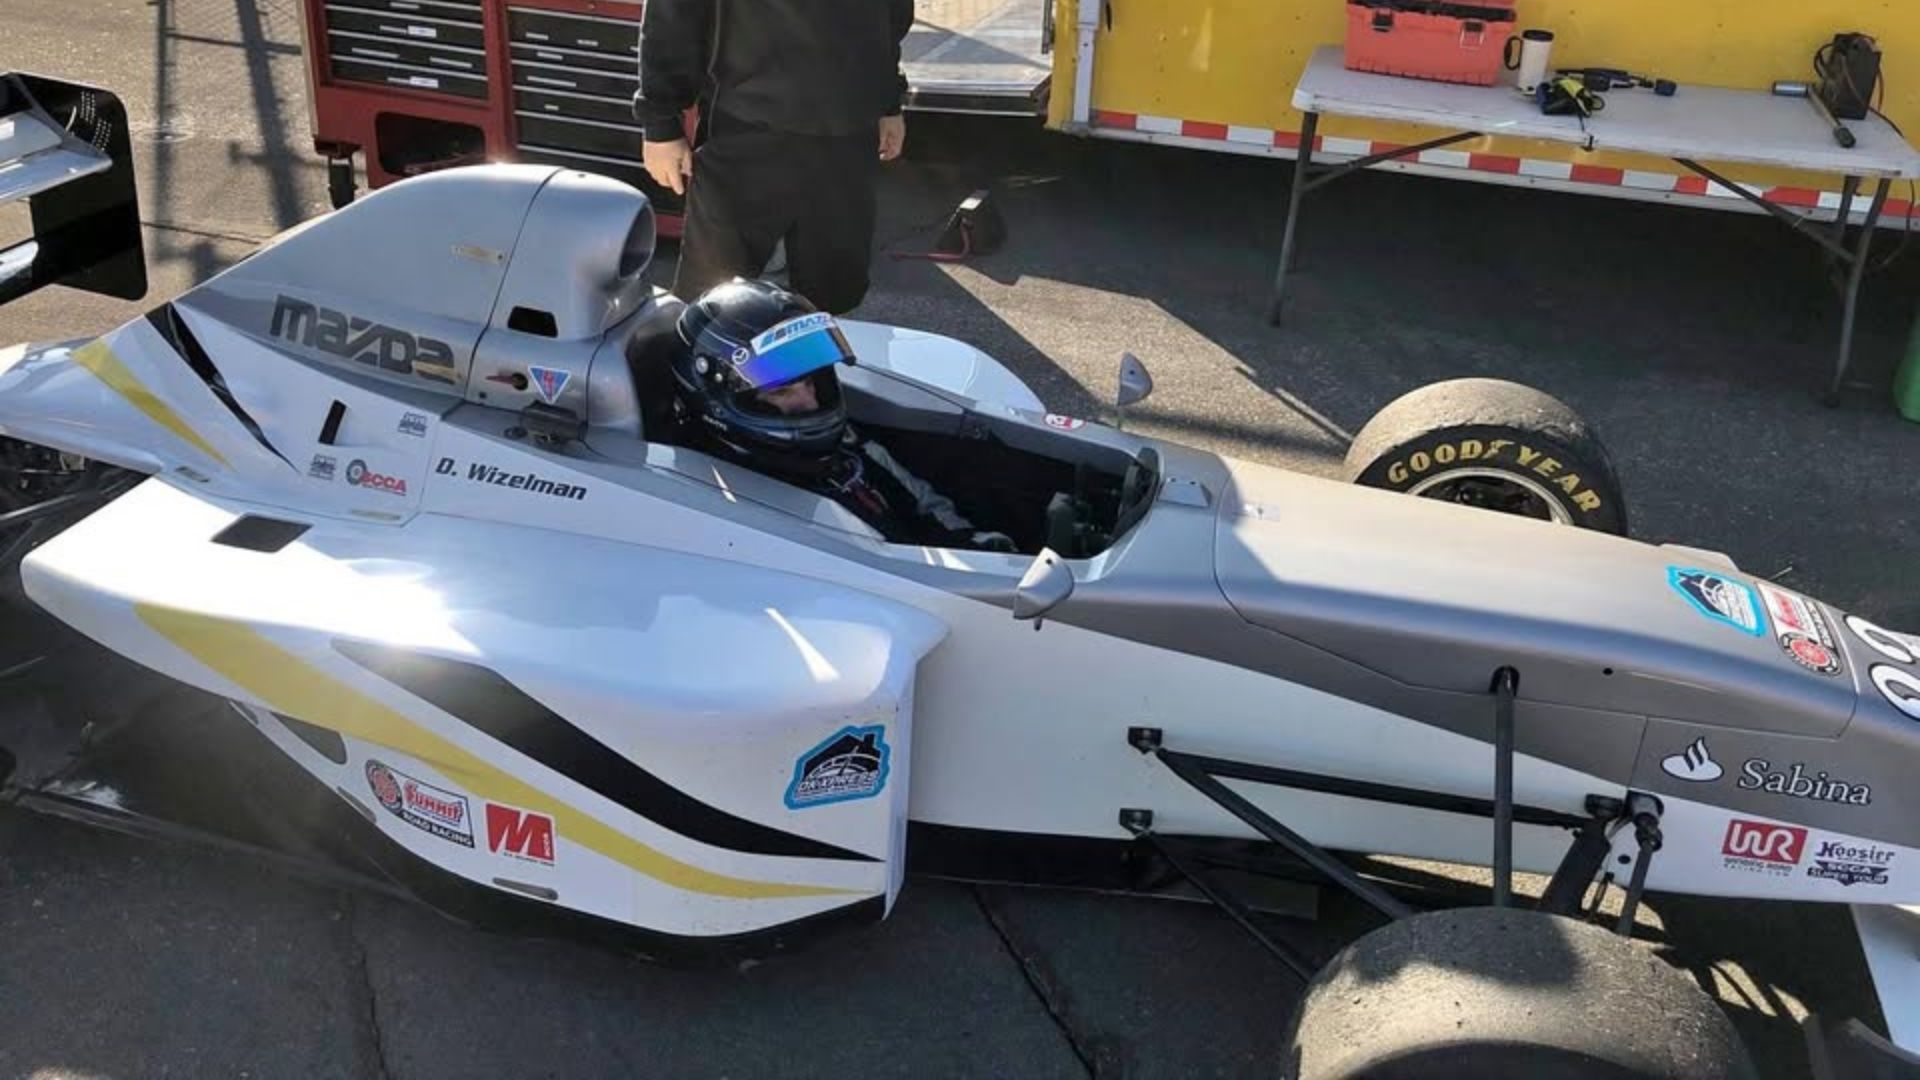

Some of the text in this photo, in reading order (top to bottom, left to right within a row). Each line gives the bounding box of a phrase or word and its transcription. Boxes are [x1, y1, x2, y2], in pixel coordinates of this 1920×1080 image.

[435, 457, 587, 500] D. Wizelman
[1738, 758, 1872, 805] Sabina
[1815, 841, 1896, 862] Hoosier
